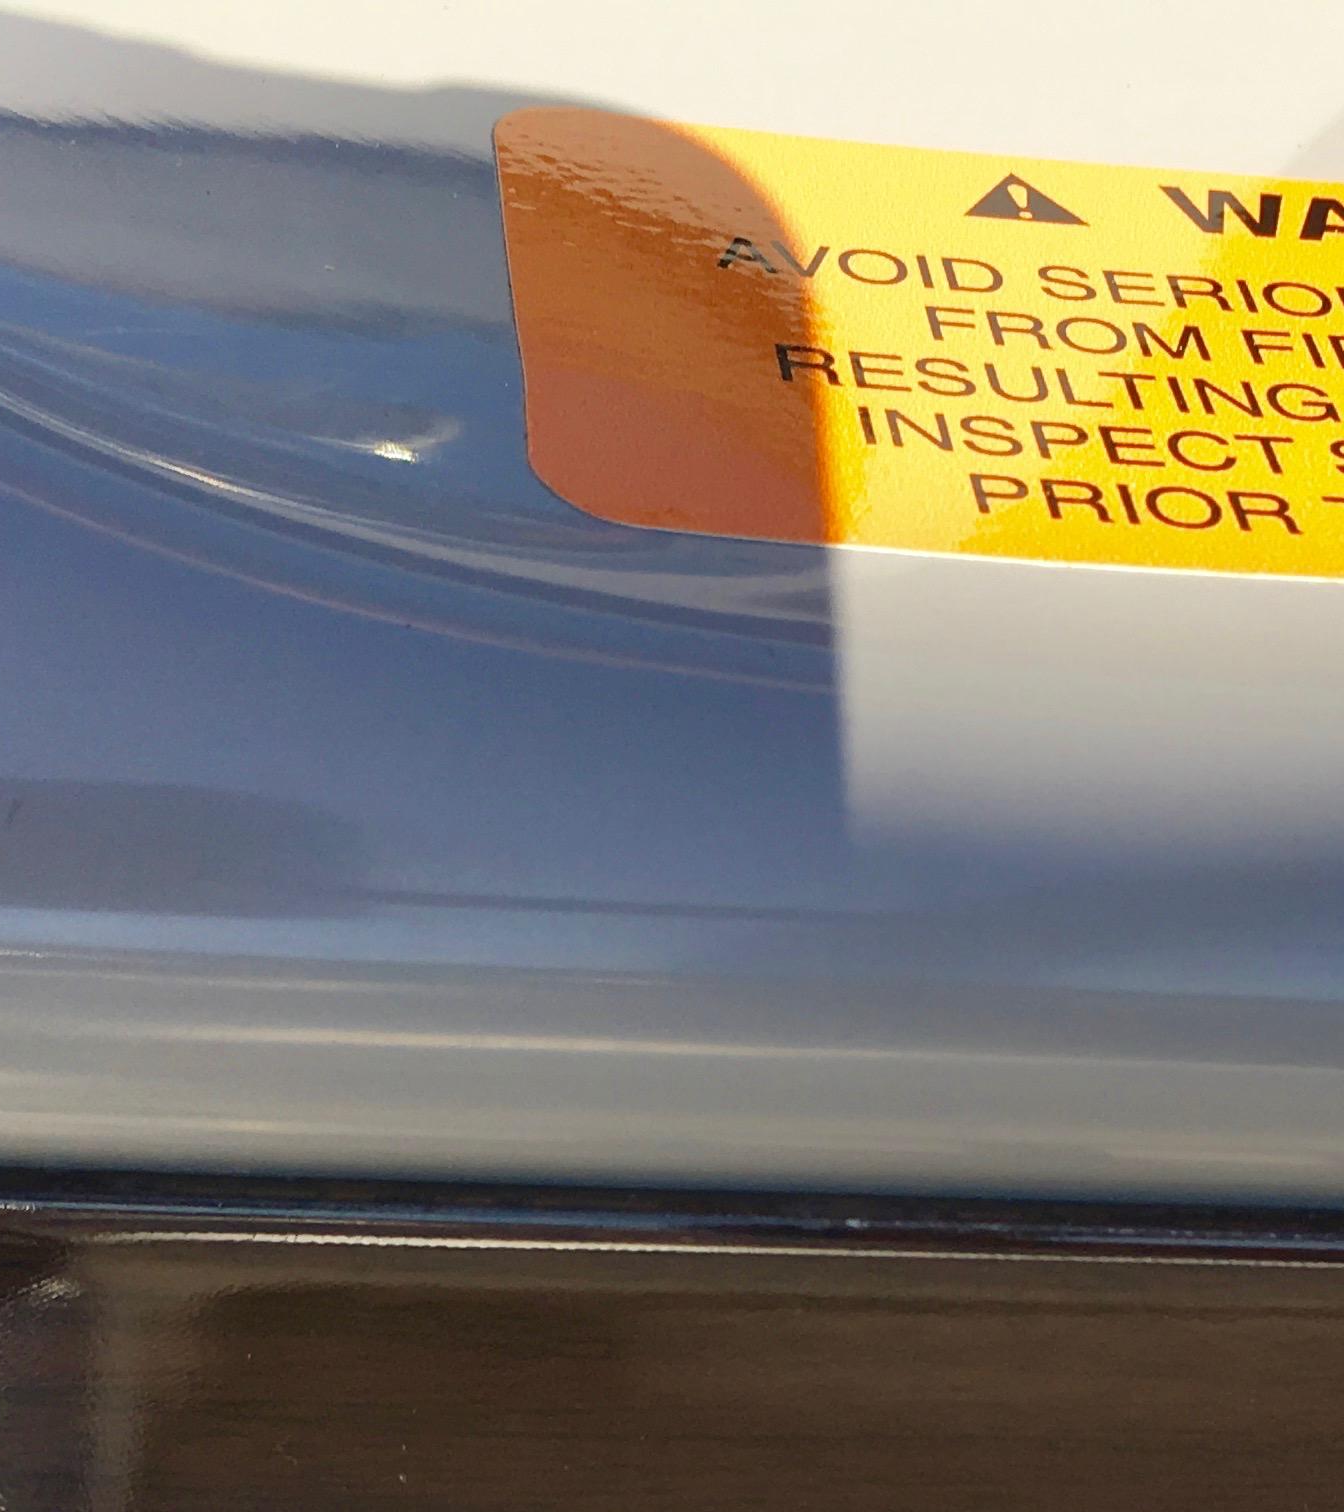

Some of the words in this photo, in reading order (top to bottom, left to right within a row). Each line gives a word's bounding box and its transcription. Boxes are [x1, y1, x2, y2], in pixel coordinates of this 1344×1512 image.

[715, 238, 1003, 295] AVOID
[926, 306, 1208, 363] FROM
[774, 343, 1341, 423] RESULTING
[860, 406, 1294, 473] INSPECT
[973, 474, 1302, 535] PRIOR
